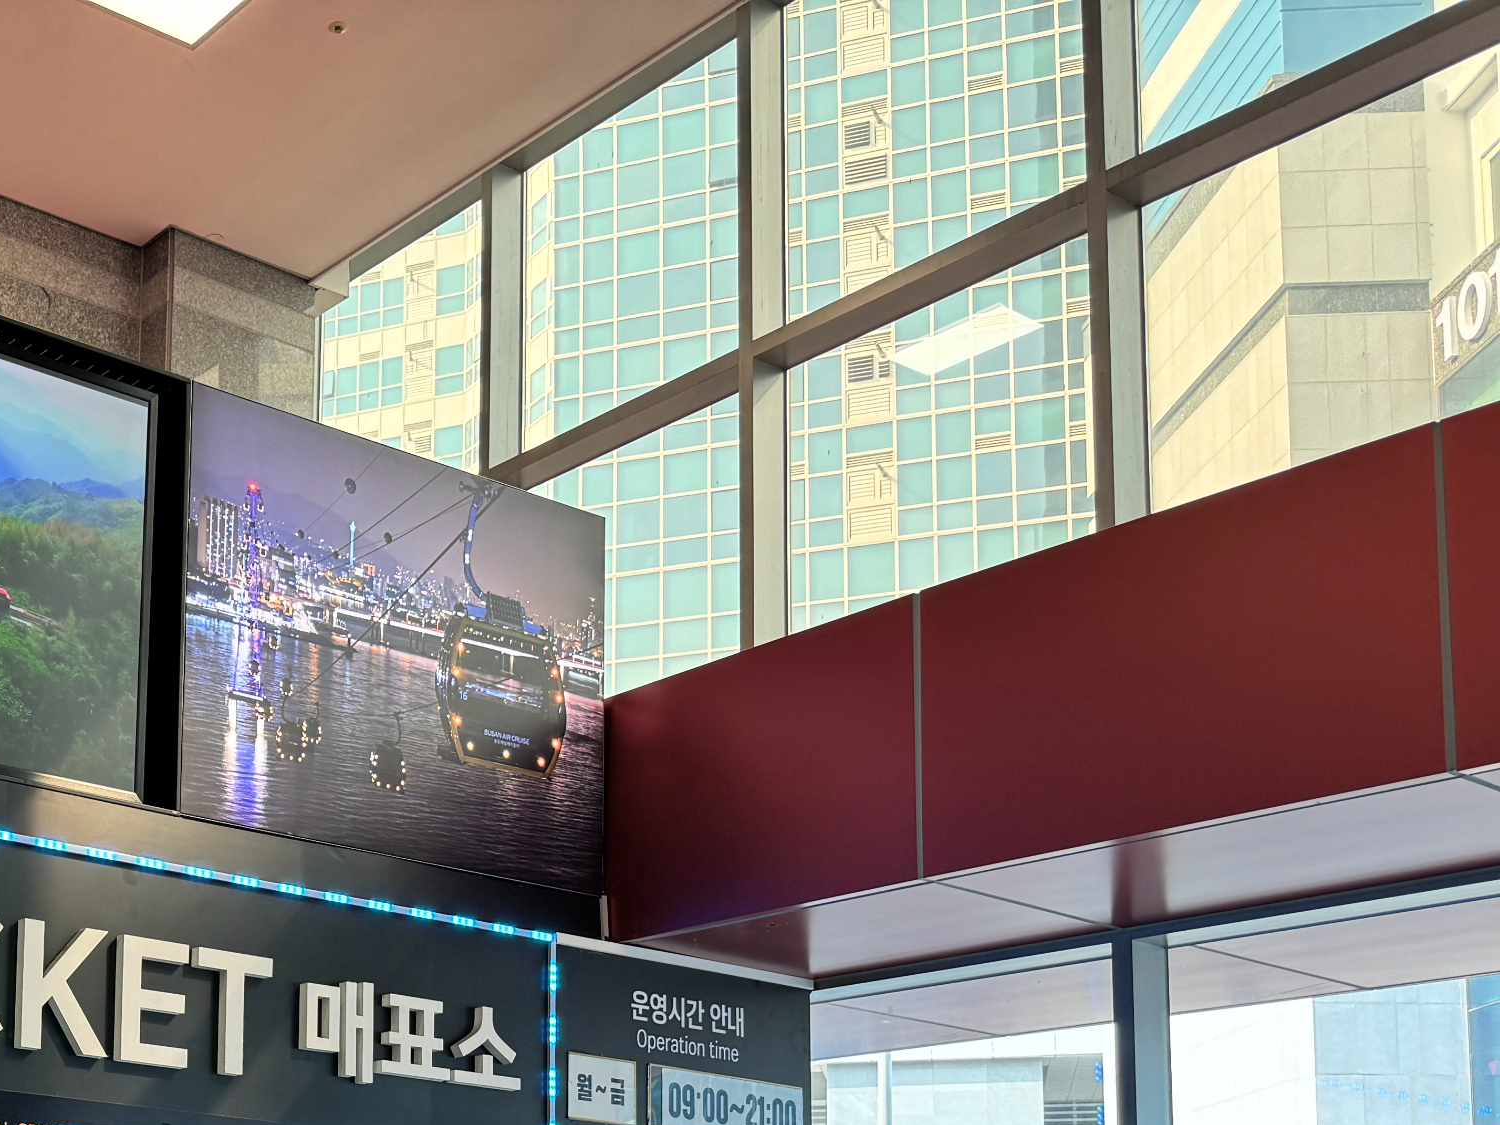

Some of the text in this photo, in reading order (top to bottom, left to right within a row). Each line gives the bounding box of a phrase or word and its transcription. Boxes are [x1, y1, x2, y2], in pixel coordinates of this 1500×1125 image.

[298, 979, 521, 1090] 매표소
[631, 991, 744, 1037] 운영시간 안내
[637, 1029, 738, 1062] Operation time
